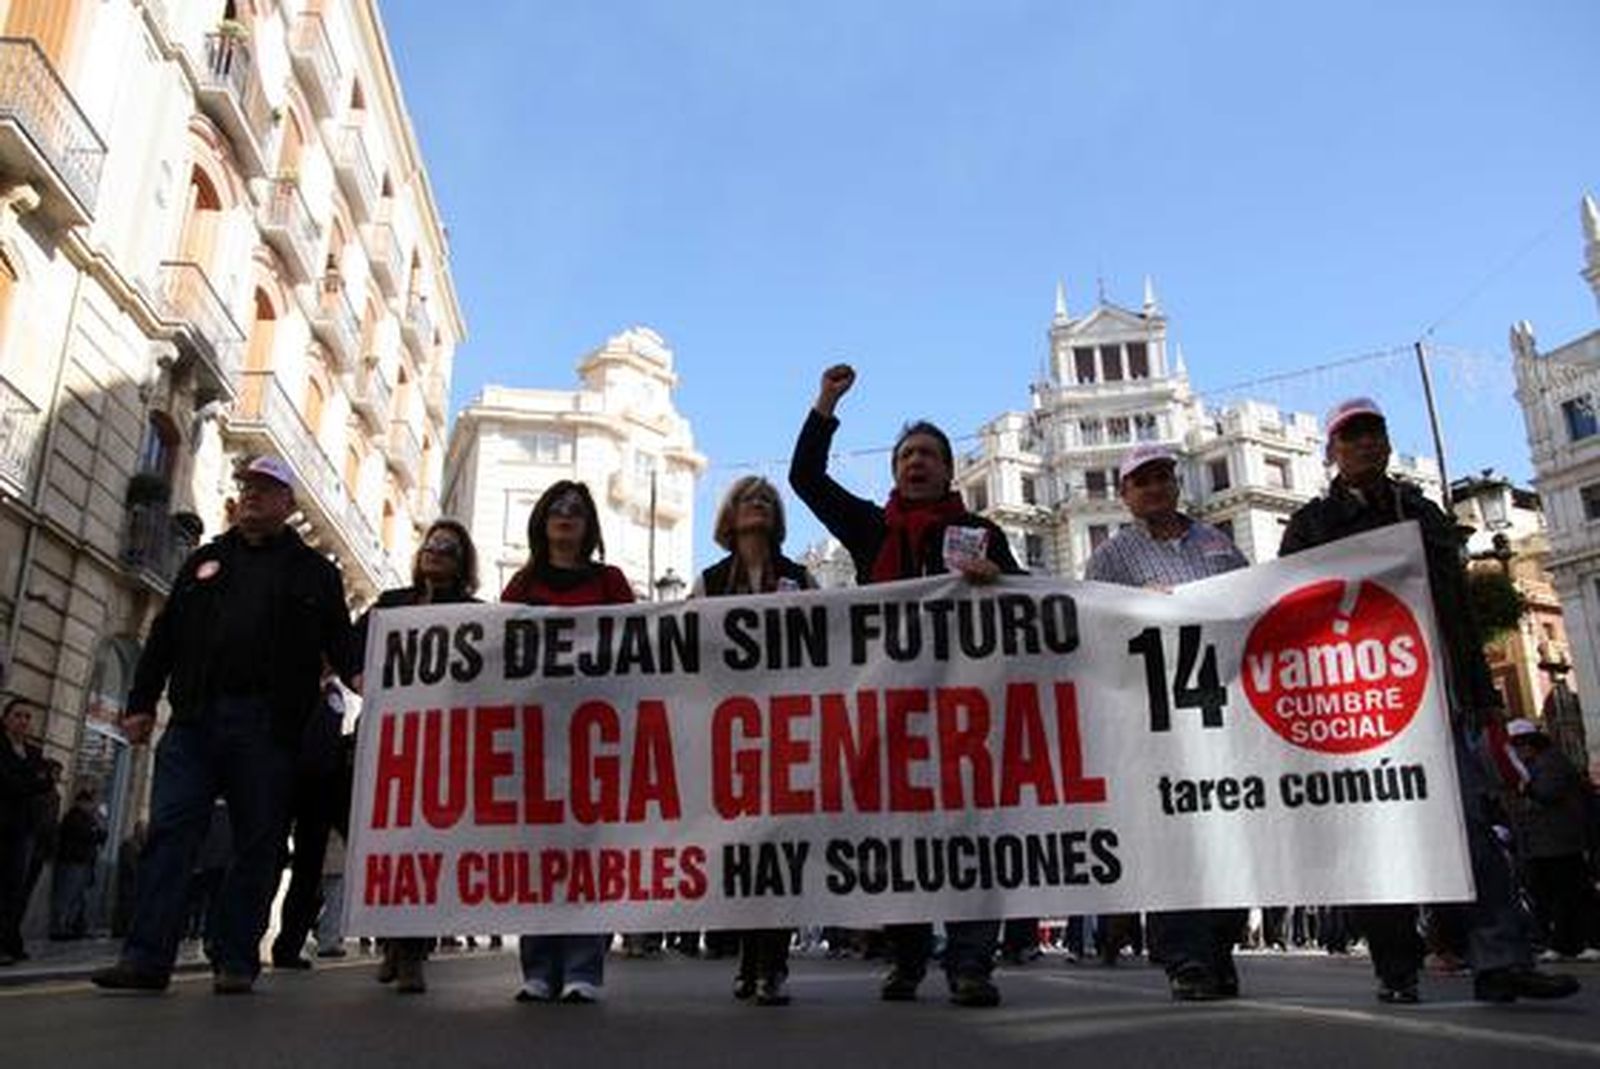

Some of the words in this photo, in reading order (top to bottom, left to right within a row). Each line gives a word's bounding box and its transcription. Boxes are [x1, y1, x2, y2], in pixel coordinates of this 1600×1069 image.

[382, 622, 484, 689] NOS
[503, 611, 700, 681] DEJAN
[723, 605, 829, 672] SIN
[849, 594, 1080, 666] FUTURO
[1247, 634, 1418, 693] vamos
[1128, 625, 1228, 732] 14
[1276, 687, 1404, 719] CUMBRE
[371, 699, 681, 830] HUELGA
[710, 681, 1107, 820] GENERAL
[1290, 715, 1395, 744] SOCIAL
[1158, 774, 1266, 816] tarea
[1279, 758, 1428, 808] común
[365, 851, 444, 907] HAY
[457, 845, 708, 906] CULPABLES
[723, 842, 810, 898] HAY
[825, 829, 1122, 896] SOLUCIONES
